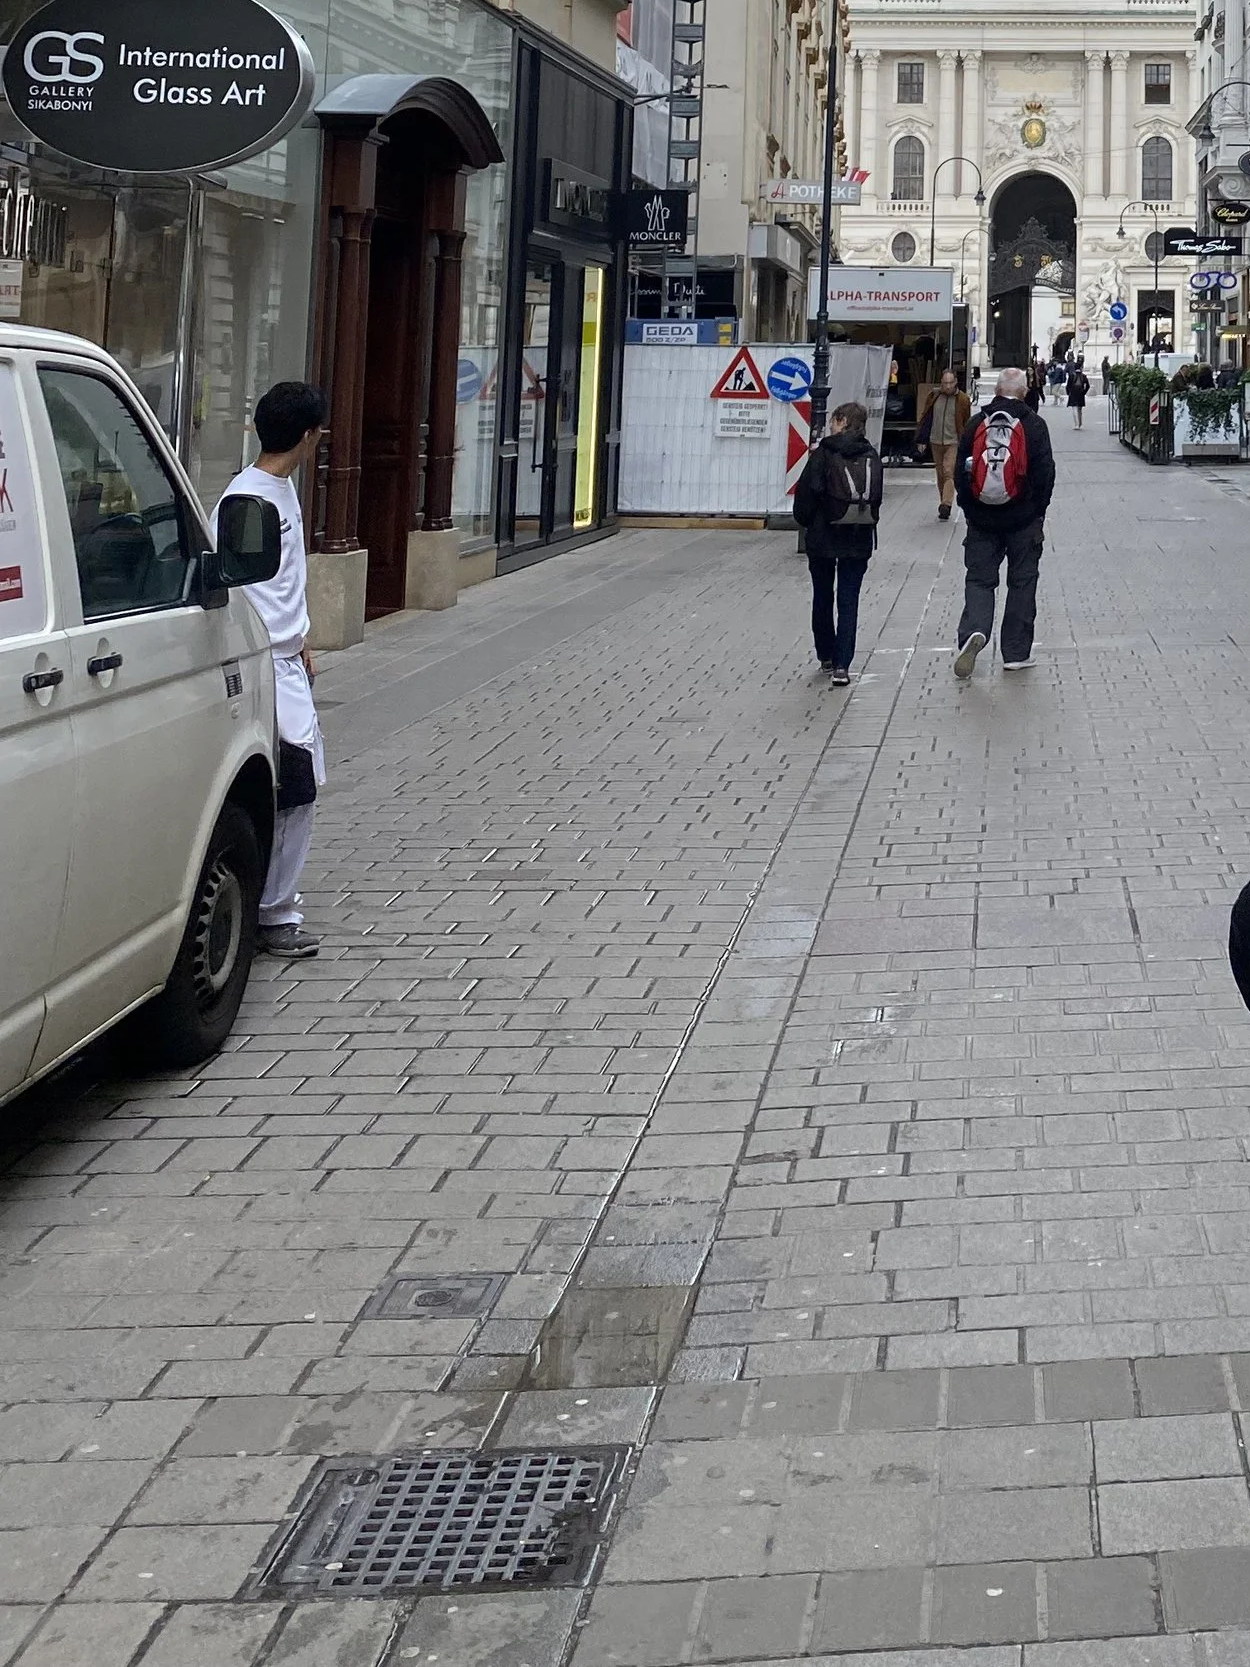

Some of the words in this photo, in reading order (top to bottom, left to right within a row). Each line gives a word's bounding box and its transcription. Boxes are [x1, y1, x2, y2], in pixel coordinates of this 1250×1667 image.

[23, 30, 105, 84] GS
[118, 43, 286, 71] International
[28, 84, 95, 98] GALLERY
[132, 77, 212, 106] Glass
[221, 80, 267, 107] Art
[26, 98, 94, 112] SIKABONYI
[629, 231, 682, 242] MONCLER
[1169, 239, 1205, 252] Thomas
[1201, 239, 1237, 253] Sabo
[646, 326, 694, 336] GEDA
